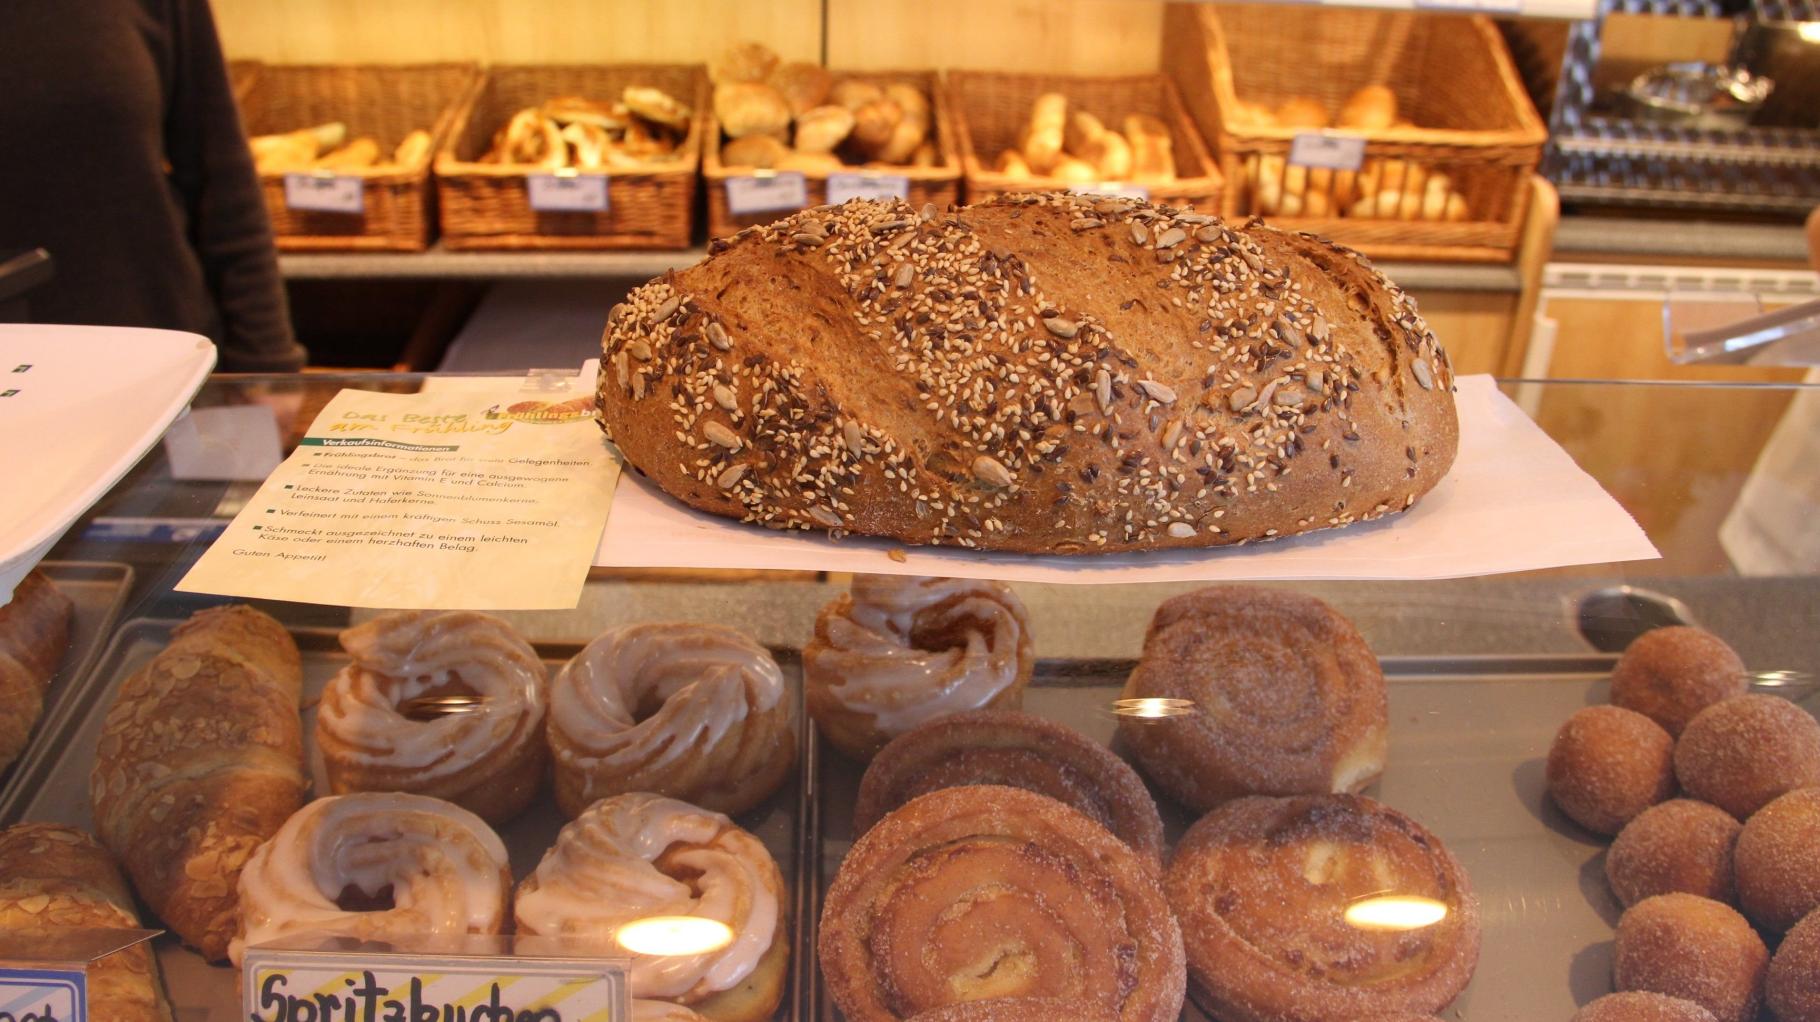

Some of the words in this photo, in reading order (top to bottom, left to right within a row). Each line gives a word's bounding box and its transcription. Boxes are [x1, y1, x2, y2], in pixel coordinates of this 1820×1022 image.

[342, 411, 388, 422] Das
[402, 413, 467, 424] Beste
[322, 438, 451, 451] Verkaufsinformationen
[323, 452, 397, 460] Frühlingsbrot
[508, 457, 592, 467] Gelegenheiten.
[308, 468, 367, 479] Ernährung
[393, 475, 435, 483] Vitamin
[451, 478, 473, 487] und
[477, 479, 527, 489] Calcium.
[337, 463, 372, 472] ideale
[376, 466, 438, 476] Ergänzung
[441, 469, 457, 478] für
[460, 471, 485, 479] eine
[489, 473, 569, 483] ausgewogene
[291, 492, 339, 502] Leinsaat
[343, 496, 365, 504] und
[297, 485, 340, 494] Leckere
[344, 488, 387, 497] Zutaten
[280, 508, 337, 520] Verfeinert
[403, 512, 456, 523] kräftigen
[462, 517, 501, 526] Schuss
[506, 517, 560, 528] Sesamöl.
[258, 533, 288, 542] Käse
[293, 535, 321, 544] oder
[368, 537, 435, 550] herzhaften
[440, 542, 478, 552] Belag.
[265, 525, 322, 536] Schmeckt
[326, 529, 415, 539] ausgezeichnet
[438, 534, 476, 543] einem
[480, 534, 528, 545] leichten
[232, 549, 270, 558] Guten
[275, 551, 327, 562] Appetit!
[250, 970, 564, 1022] Spritzkuchen
